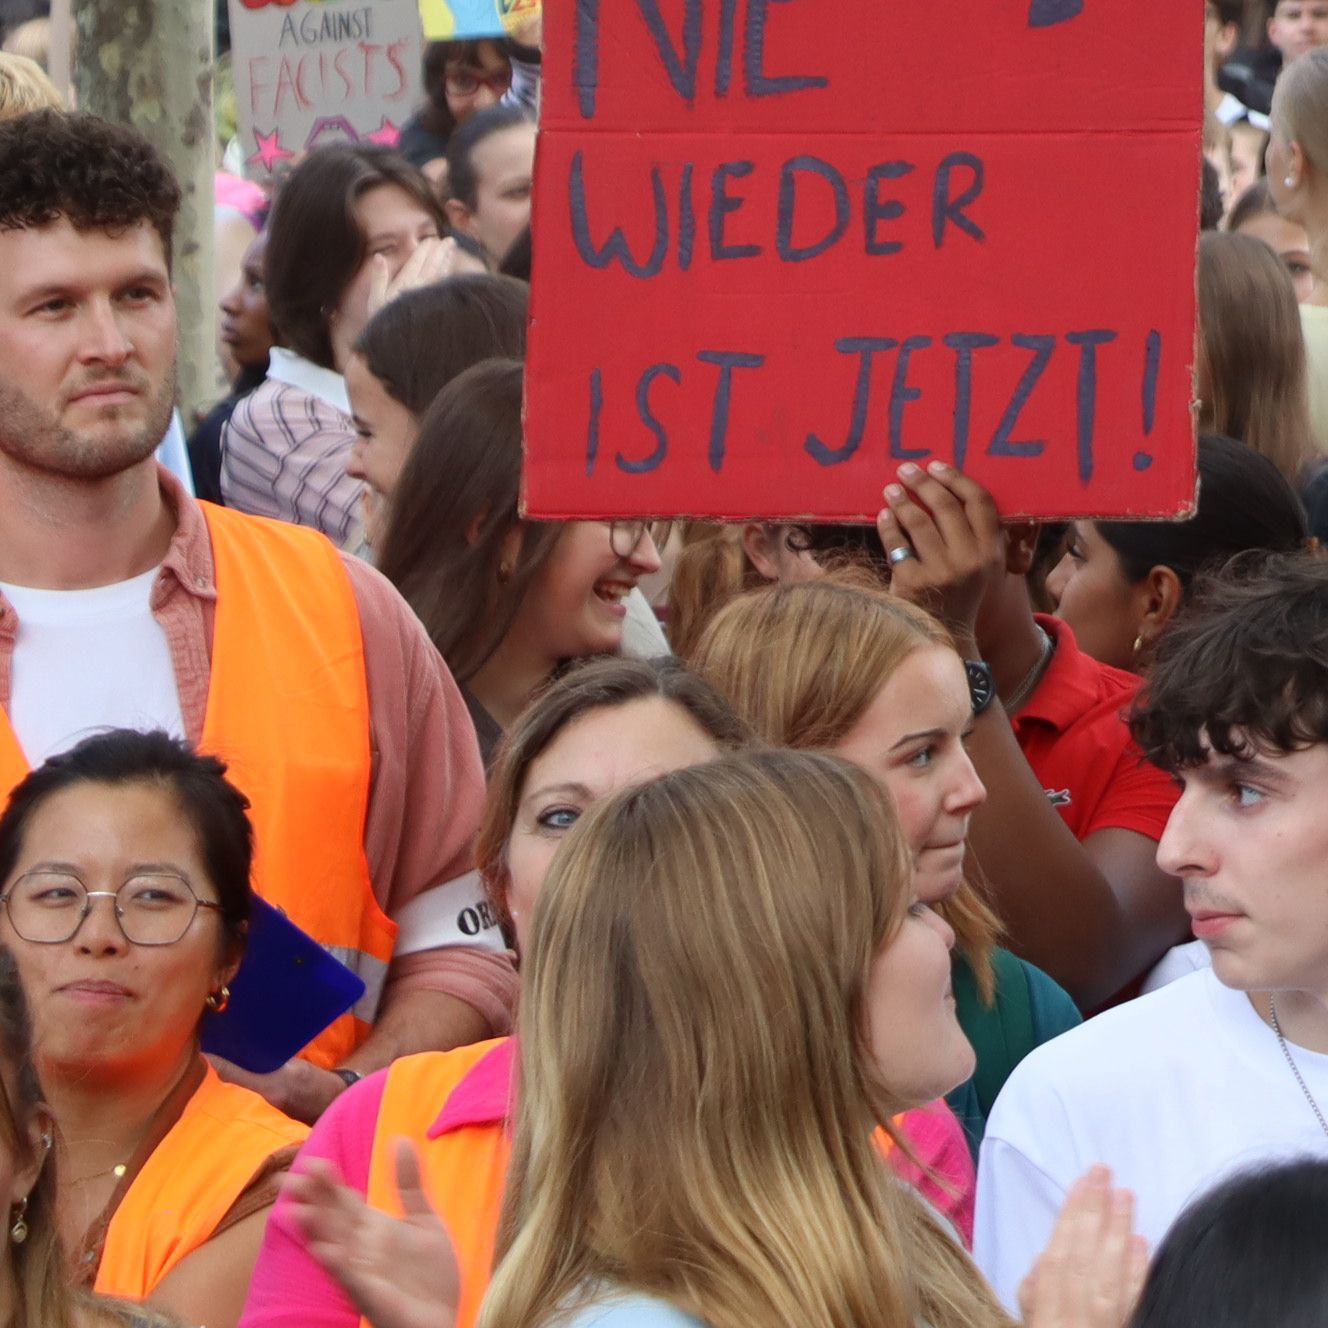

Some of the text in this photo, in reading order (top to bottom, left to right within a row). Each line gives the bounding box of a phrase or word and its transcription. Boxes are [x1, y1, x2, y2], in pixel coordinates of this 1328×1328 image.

[248, 38, 410, 118] FACISTS
[278, 7, 373, 49] AGAINST
[567, 149, 986, 279] WIEDER
[583, 328, 1162, 488] IST JETZT!
